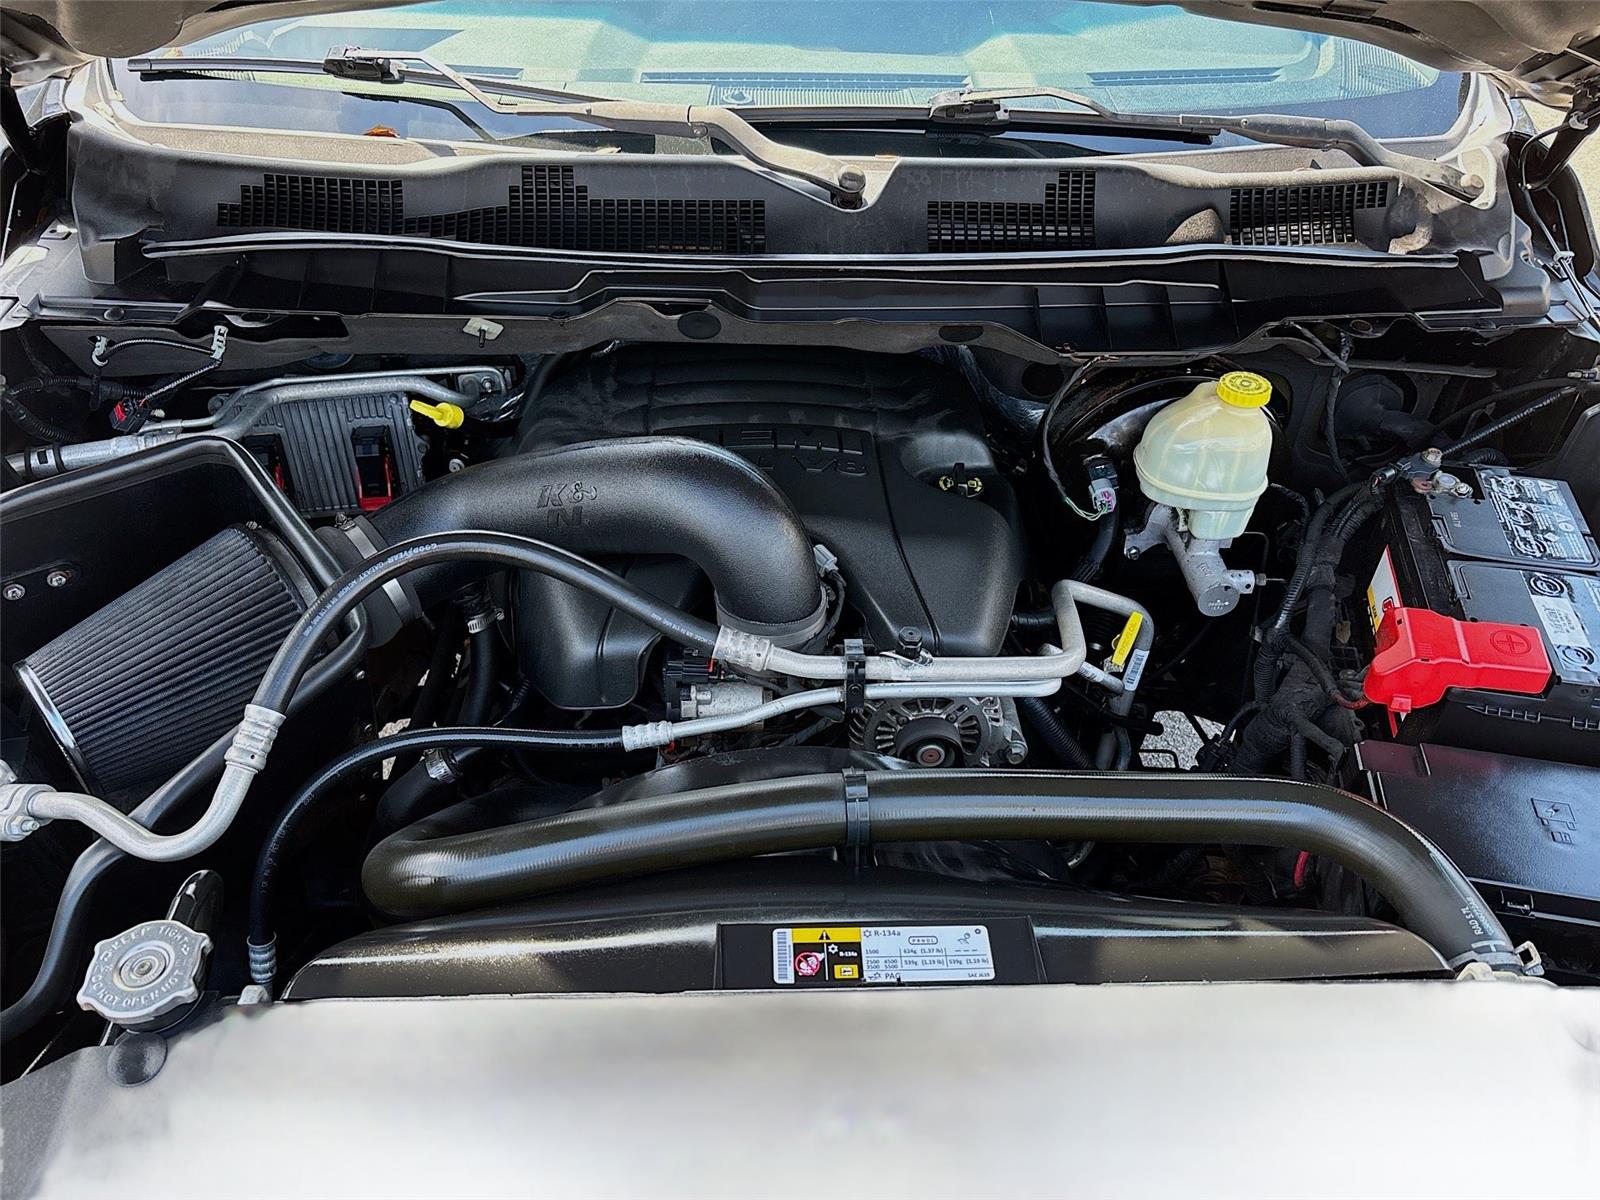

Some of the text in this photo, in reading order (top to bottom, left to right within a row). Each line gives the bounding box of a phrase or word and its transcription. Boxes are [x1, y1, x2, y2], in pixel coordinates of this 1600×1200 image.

[387, 542, 438, 562] GOODYEAR
[874, 929, 901, 937] R-134a
[1469, 919, 1483, 935] RAD
